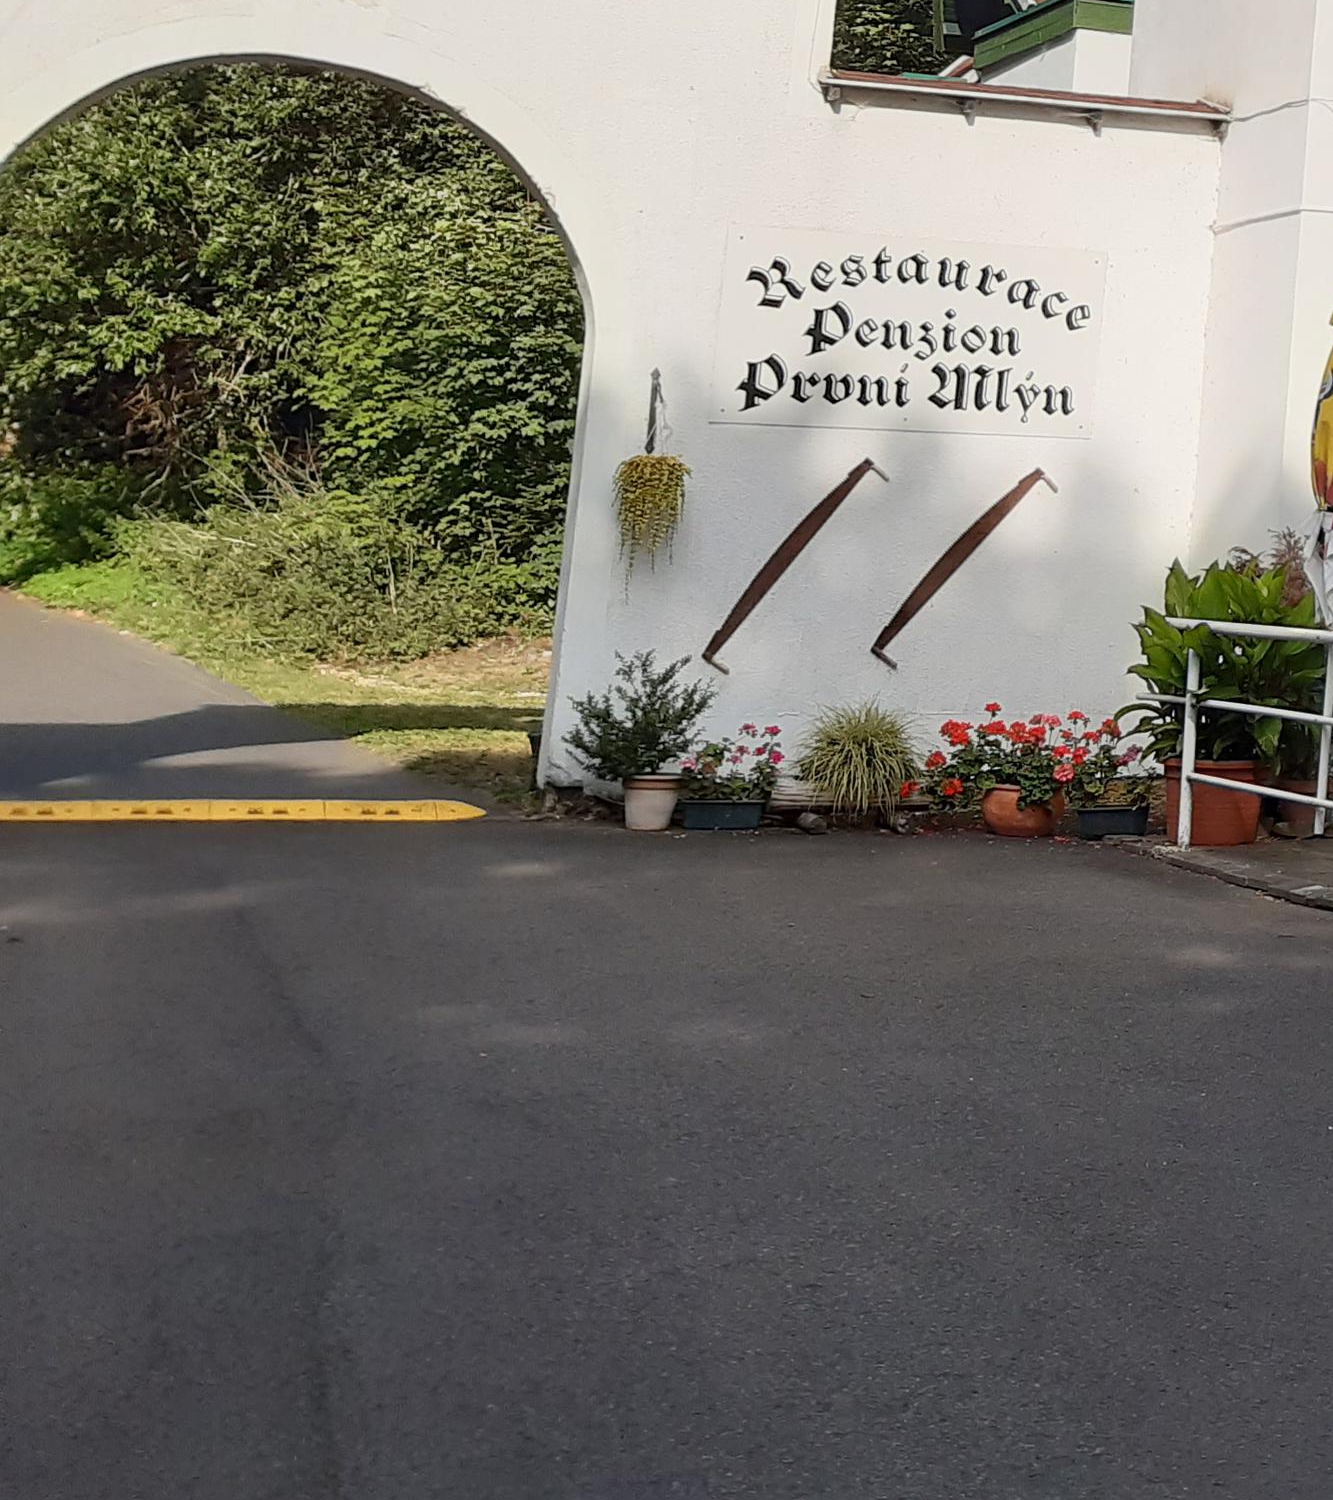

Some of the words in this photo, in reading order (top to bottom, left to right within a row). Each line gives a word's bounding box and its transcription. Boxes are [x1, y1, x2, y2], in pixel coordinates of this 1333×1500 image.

[746, 246, 1091, 331] Restaurace
[802, 300, 1022, 360] Penzion
[735, 353, 911, 412] První
[927, 361, 1075, 423] Mlýn
